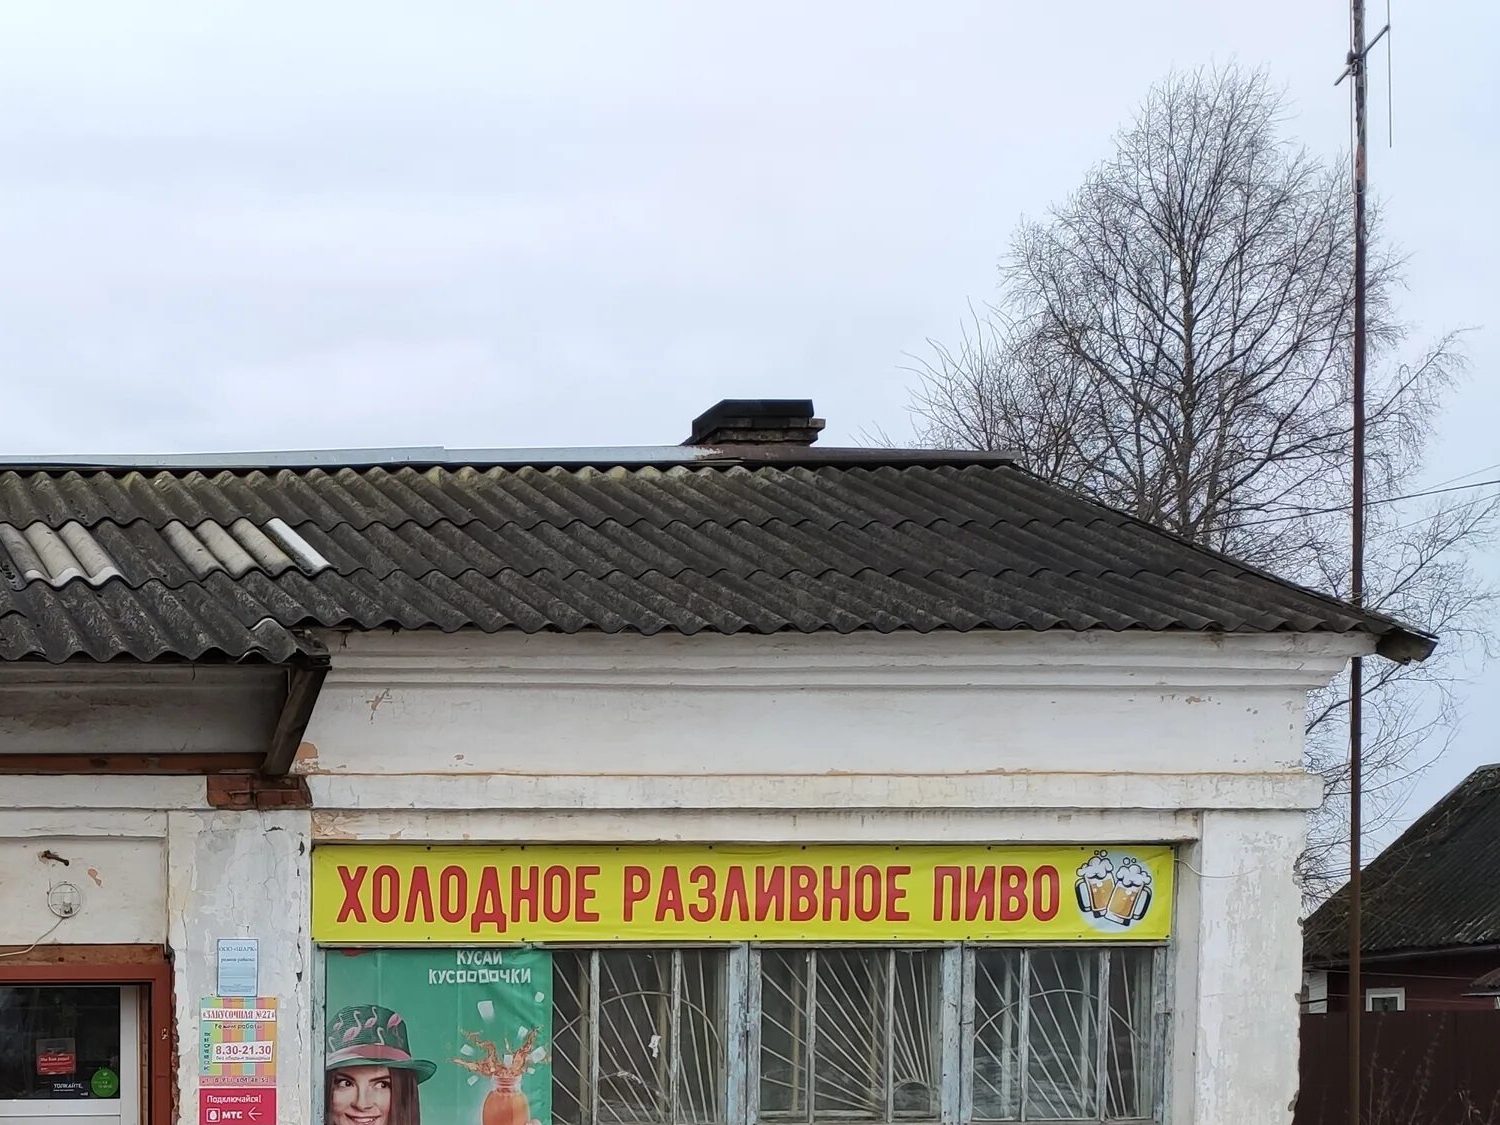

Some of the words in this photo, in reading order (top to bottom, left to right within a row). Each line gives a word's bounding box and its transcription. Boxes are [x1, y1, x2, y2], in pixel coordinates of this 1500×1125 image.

[335, 865, 602, 934] ХОЛОДНОЕ
[622, 865, 912, 923] РАЗЛИВНОЕ
[932, 865, 1061, 923] ПИВО
[215, 1045, 271, 1055] 8.30-21.30
[206, 1095, 261, 1104] Подключайся!
[222, 1111, 243, 1119] МТС
